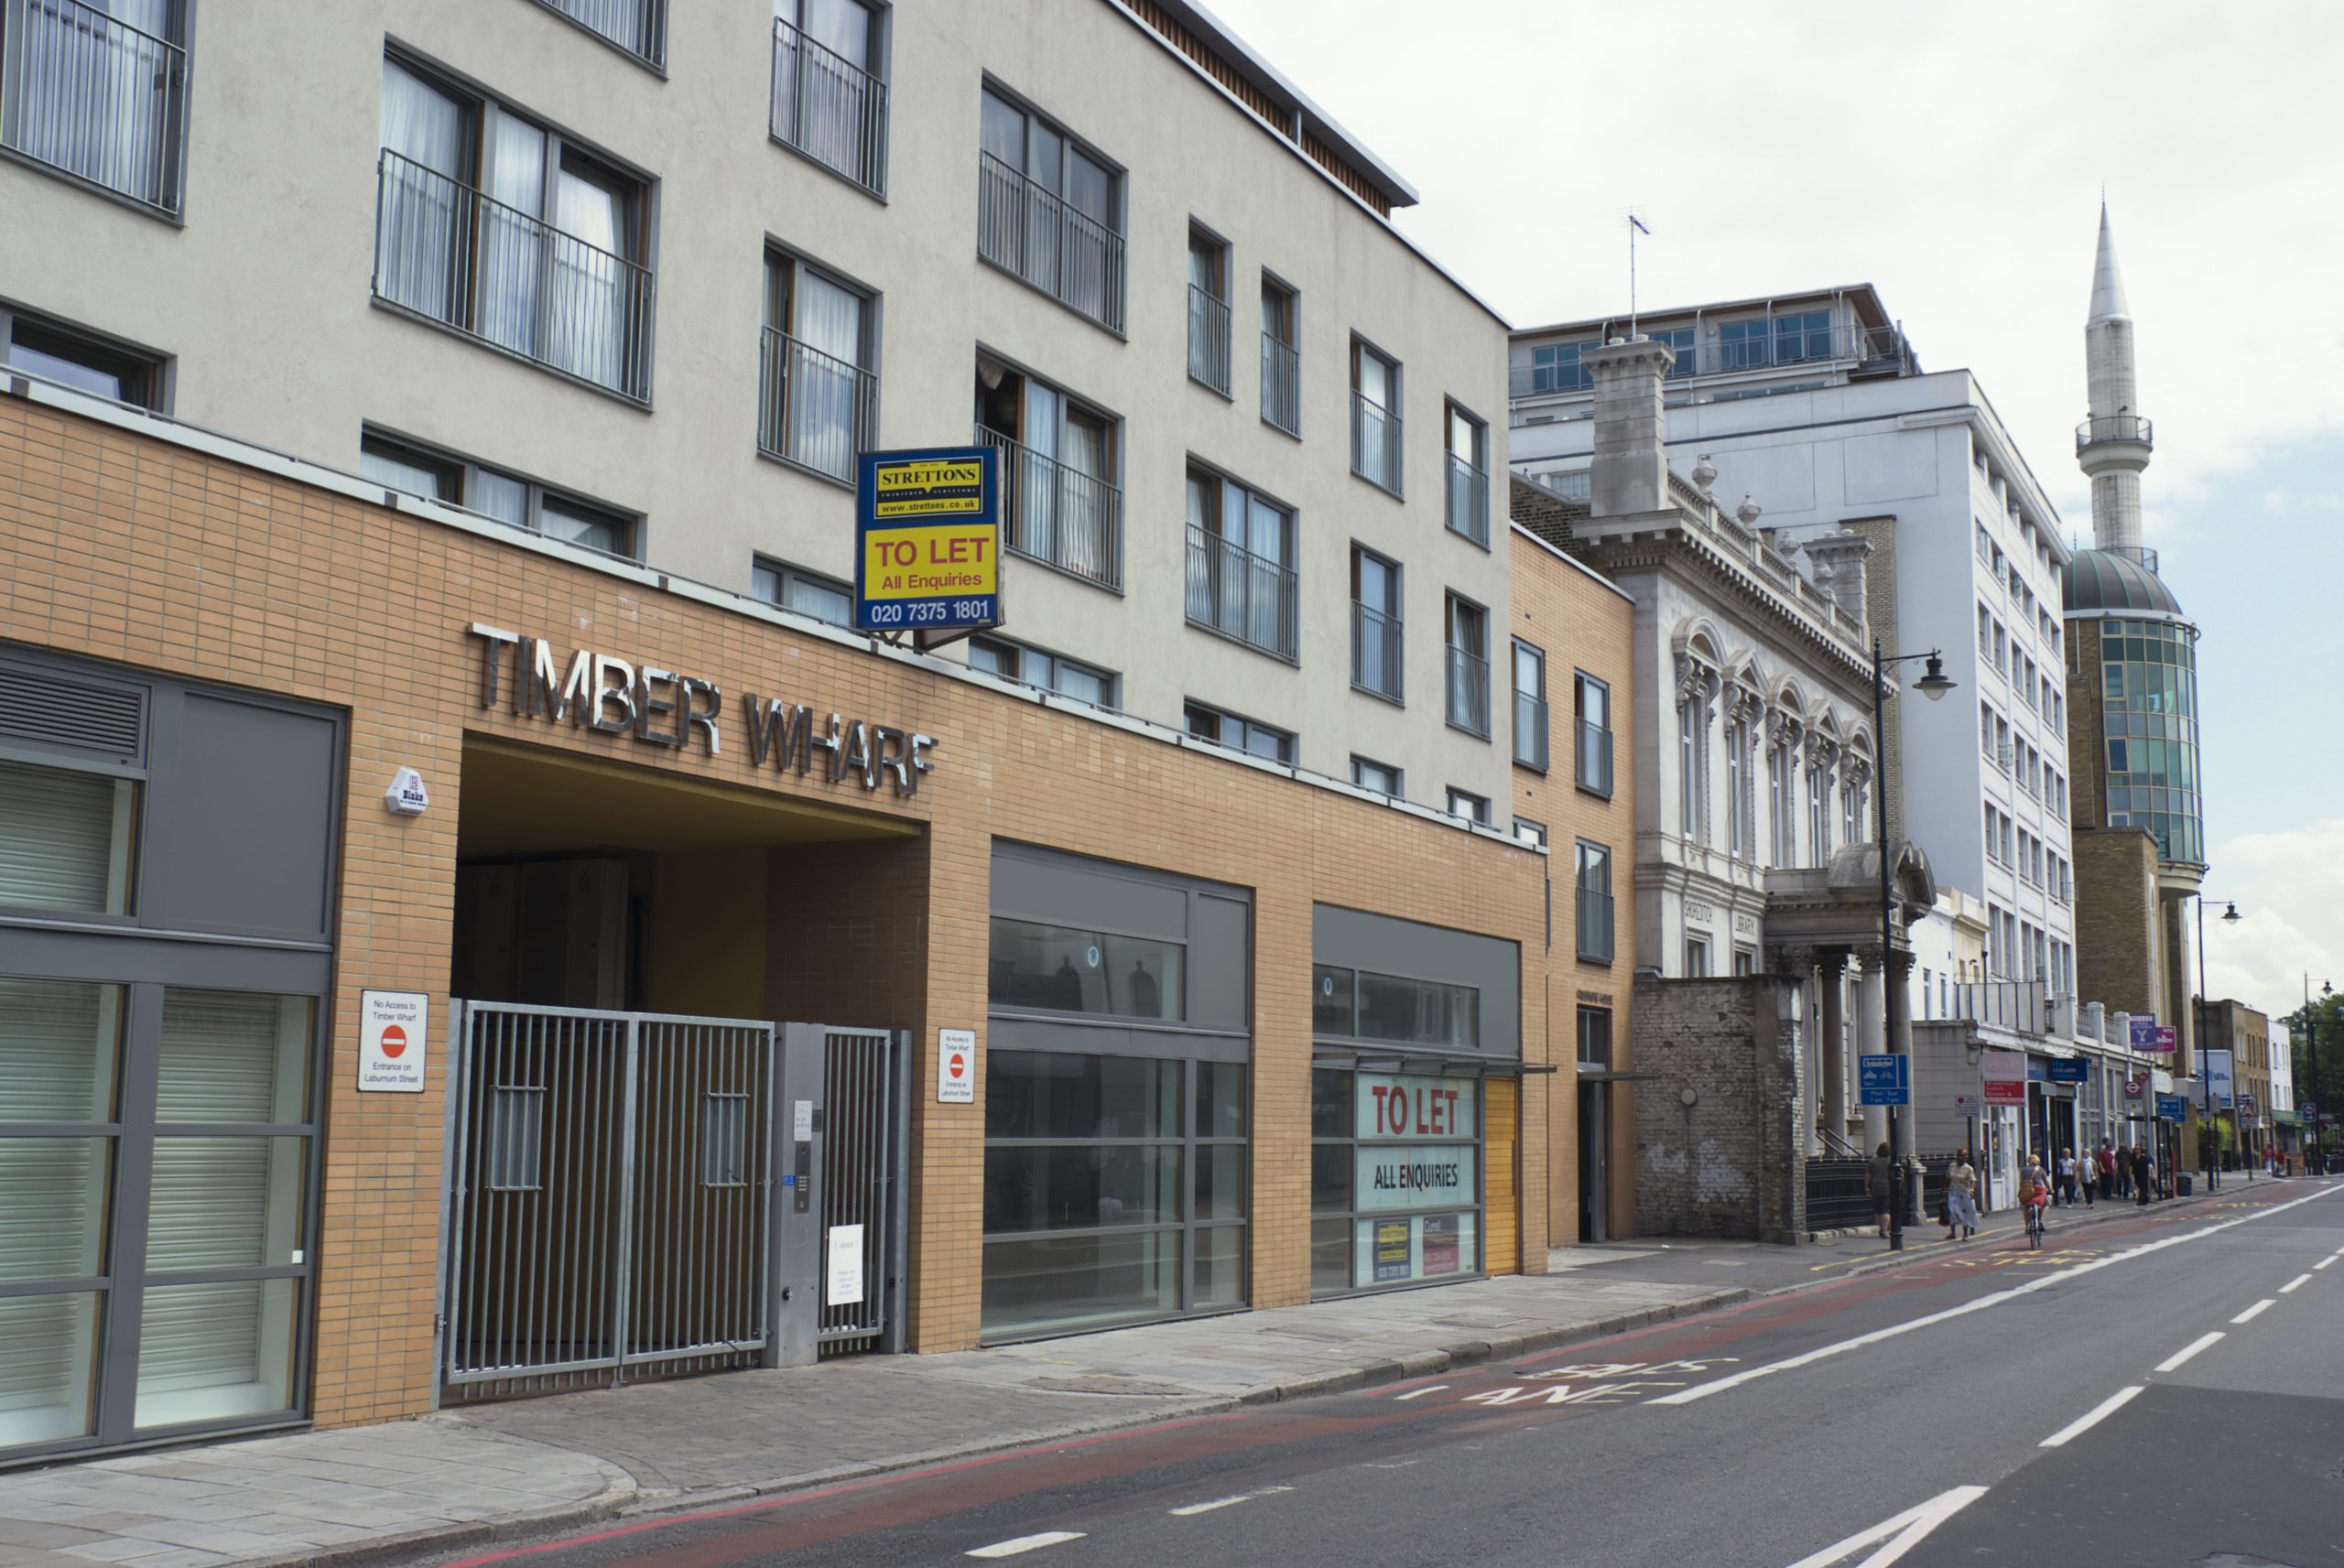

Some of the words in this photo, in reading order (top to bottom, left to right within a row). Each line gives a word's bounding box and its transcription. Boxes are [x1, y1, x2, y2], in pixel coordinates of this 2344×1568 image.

[882, 468, 976, 485] STRETTONS
[882, 500, 975, 513] www.strettons.co.uk
[874, 540, 917, 568] TO
[929, 537, 990, 565] LET
[882, 576, 901, 589] All
[907, 572, 982, 590] Enquiries
[871, 604, 902, 623] 020
[907, 602, 947, 622] 7375
[953, 600, 988, 619] 1801
[467, 622, 722, 755] TIMBER
[743, 692, 939, 796] WHARF
[374, 1000, 384, 1008] No
[385, 1000, 408, 1010] Access
[409, 1002, 416, 1011] to
[373, 1011, 396, 1021] Timber
[396, 1013, 417, 1022] Wharf
[373, 1062, 402, 1071] Entrance
[364, 1074, 397, 1083] Laburnum
[398, 1075, 418, 1084] Street
[1372, 1086, 1408, 1135] TO
[1416, 1087, 1458, 1135] LET
[1374, 1164, 1396, 1189] ALL
[1399, 1163, 1458, 1192] ENQUIRIES
